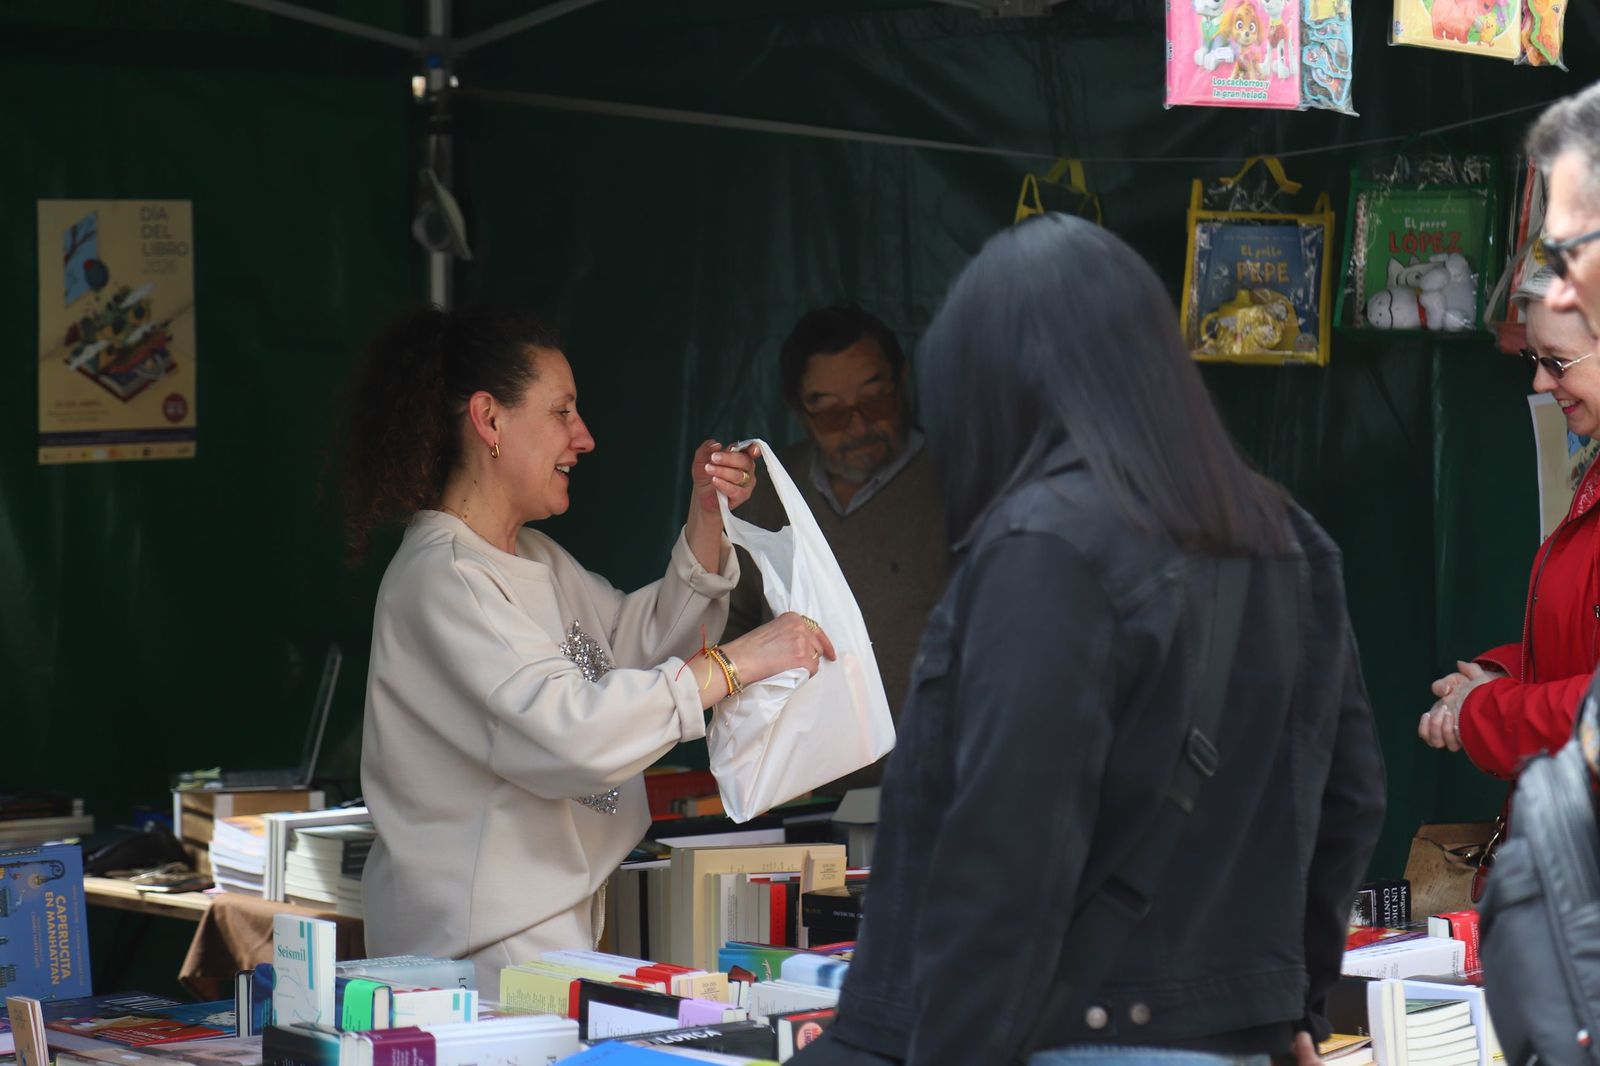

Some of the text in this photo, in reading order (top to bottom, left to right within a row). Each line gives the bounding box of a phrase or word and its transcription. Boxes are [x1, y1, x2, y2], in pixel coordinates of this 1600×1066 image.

[1213, 77, 1225, 86] Los
[1227, 78, 1263, 87] cachorros
[1213, 89, 1221, 97] la
[1241, 90, 1267, 99] helada
[141, 224, 174, 240] DEL
[1404, 216, 1447, 232] El perro
[142, 241, 189, 257] LIBRO
[1236, 261, 1290, 283] PEPE
[1391, 887, 1398, 902] UN
[44, 891, 60, 985] EN MANHATTAN
[55, 895, 72, 979] CAPERUCITA
[277, 944, 306, 961] Seismil
